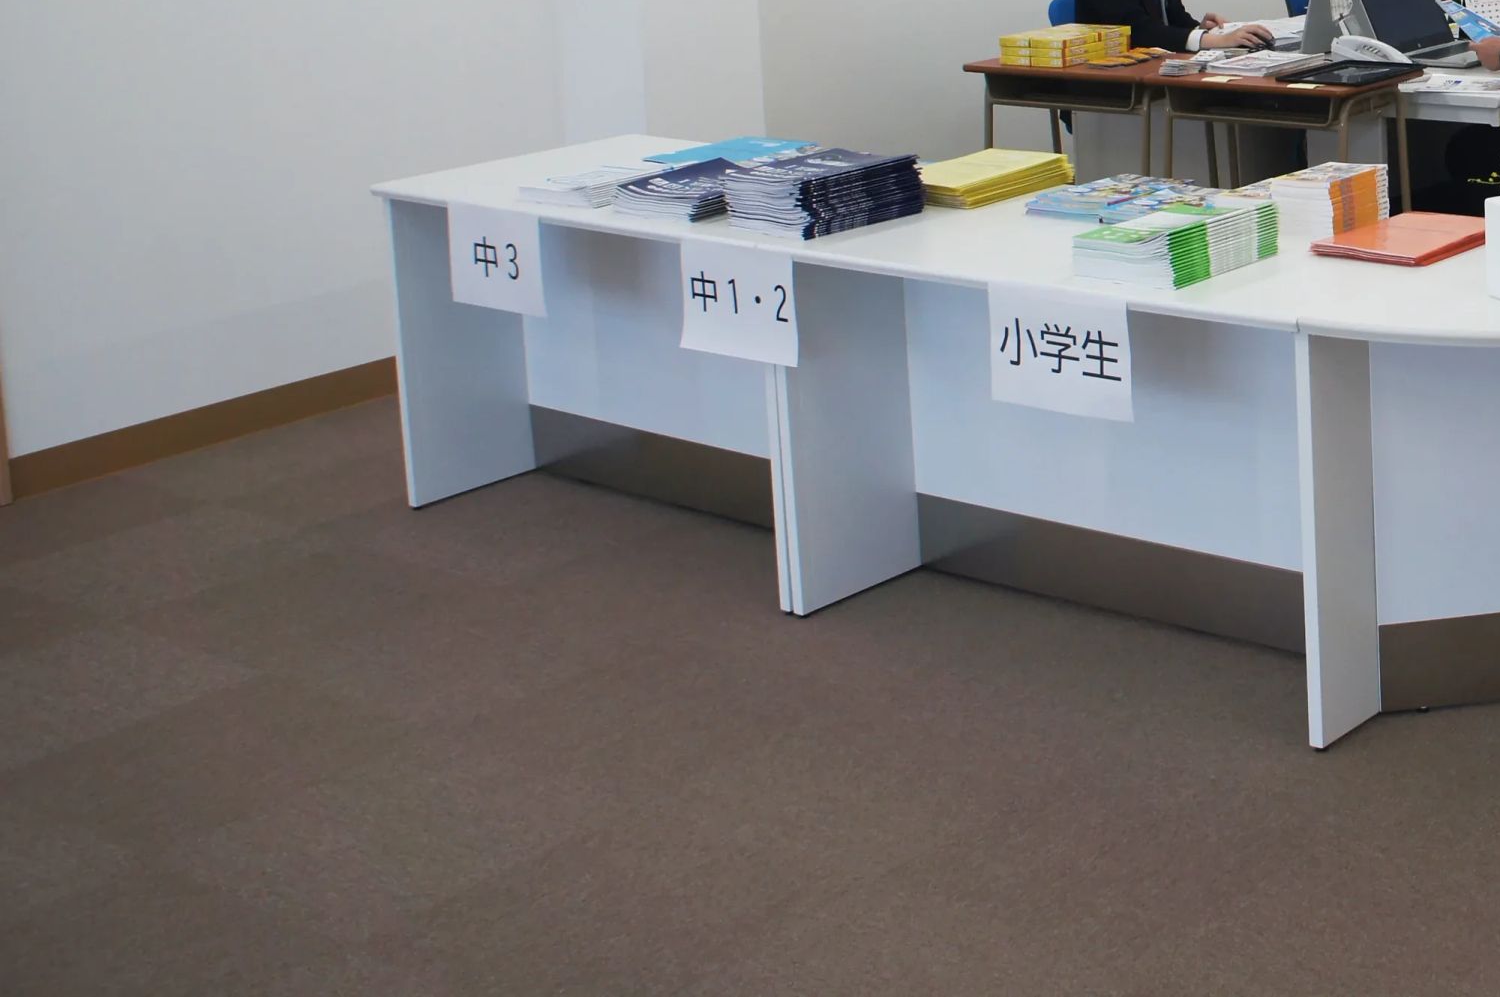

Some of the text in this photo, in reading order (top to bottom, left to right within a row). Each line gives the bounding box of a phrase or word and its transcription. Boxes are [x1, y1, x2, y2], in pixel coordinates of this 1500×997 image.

[472, 236, 521, 281] 中3
[689, 270, 790, 323] 中1・2
[999, 317, 1123, 383] 小学生
